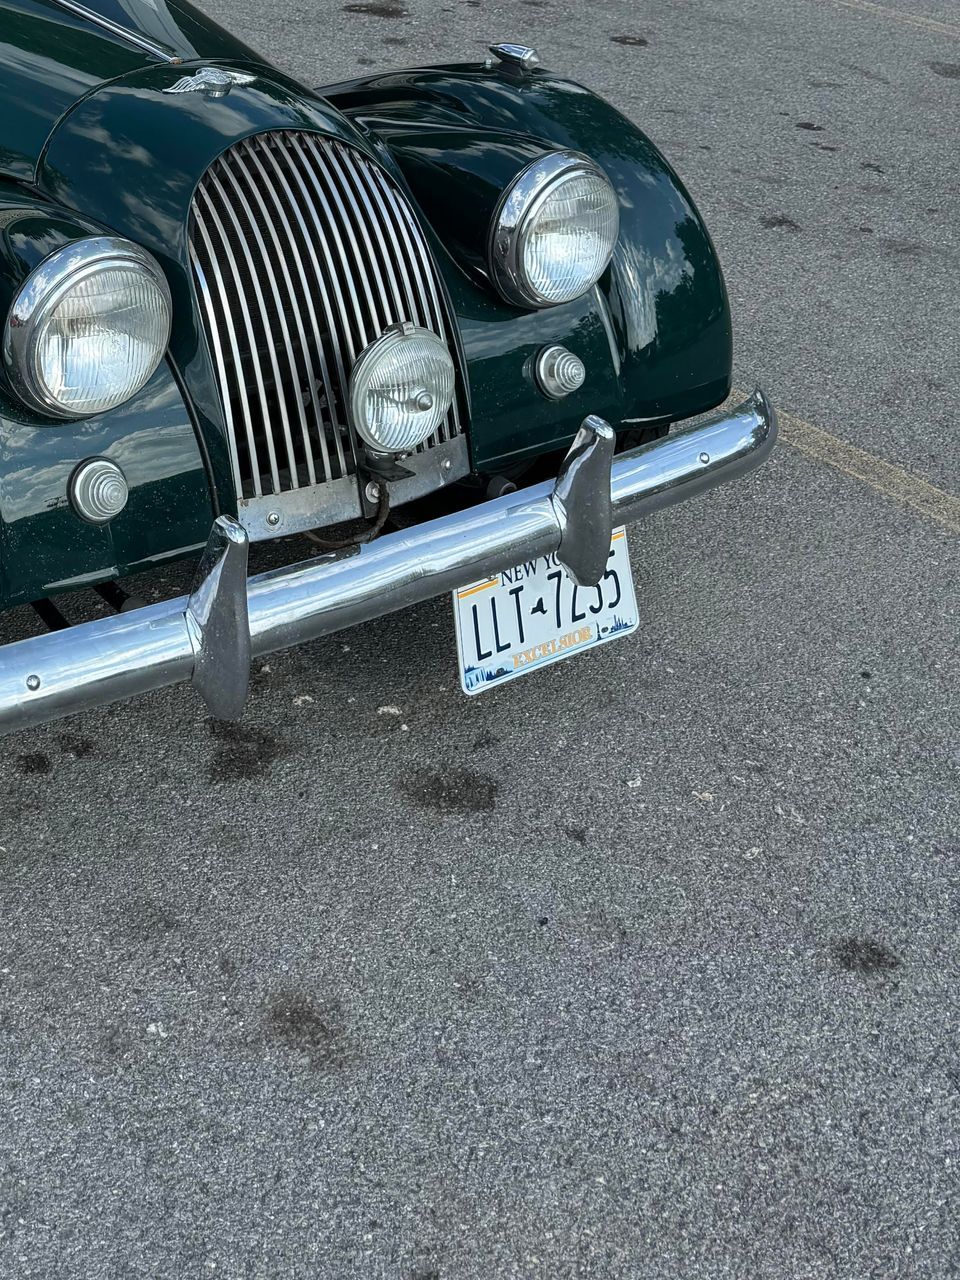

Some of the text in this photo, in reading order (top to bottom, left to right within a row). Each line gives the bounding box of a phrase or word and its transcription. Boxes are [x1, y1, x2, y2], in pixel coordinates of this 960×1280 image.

[501, 560, 539, 587] NEW
[471, 584, 525, 662] LLT
[512, 625, 593, 670] EXCELSIOR
